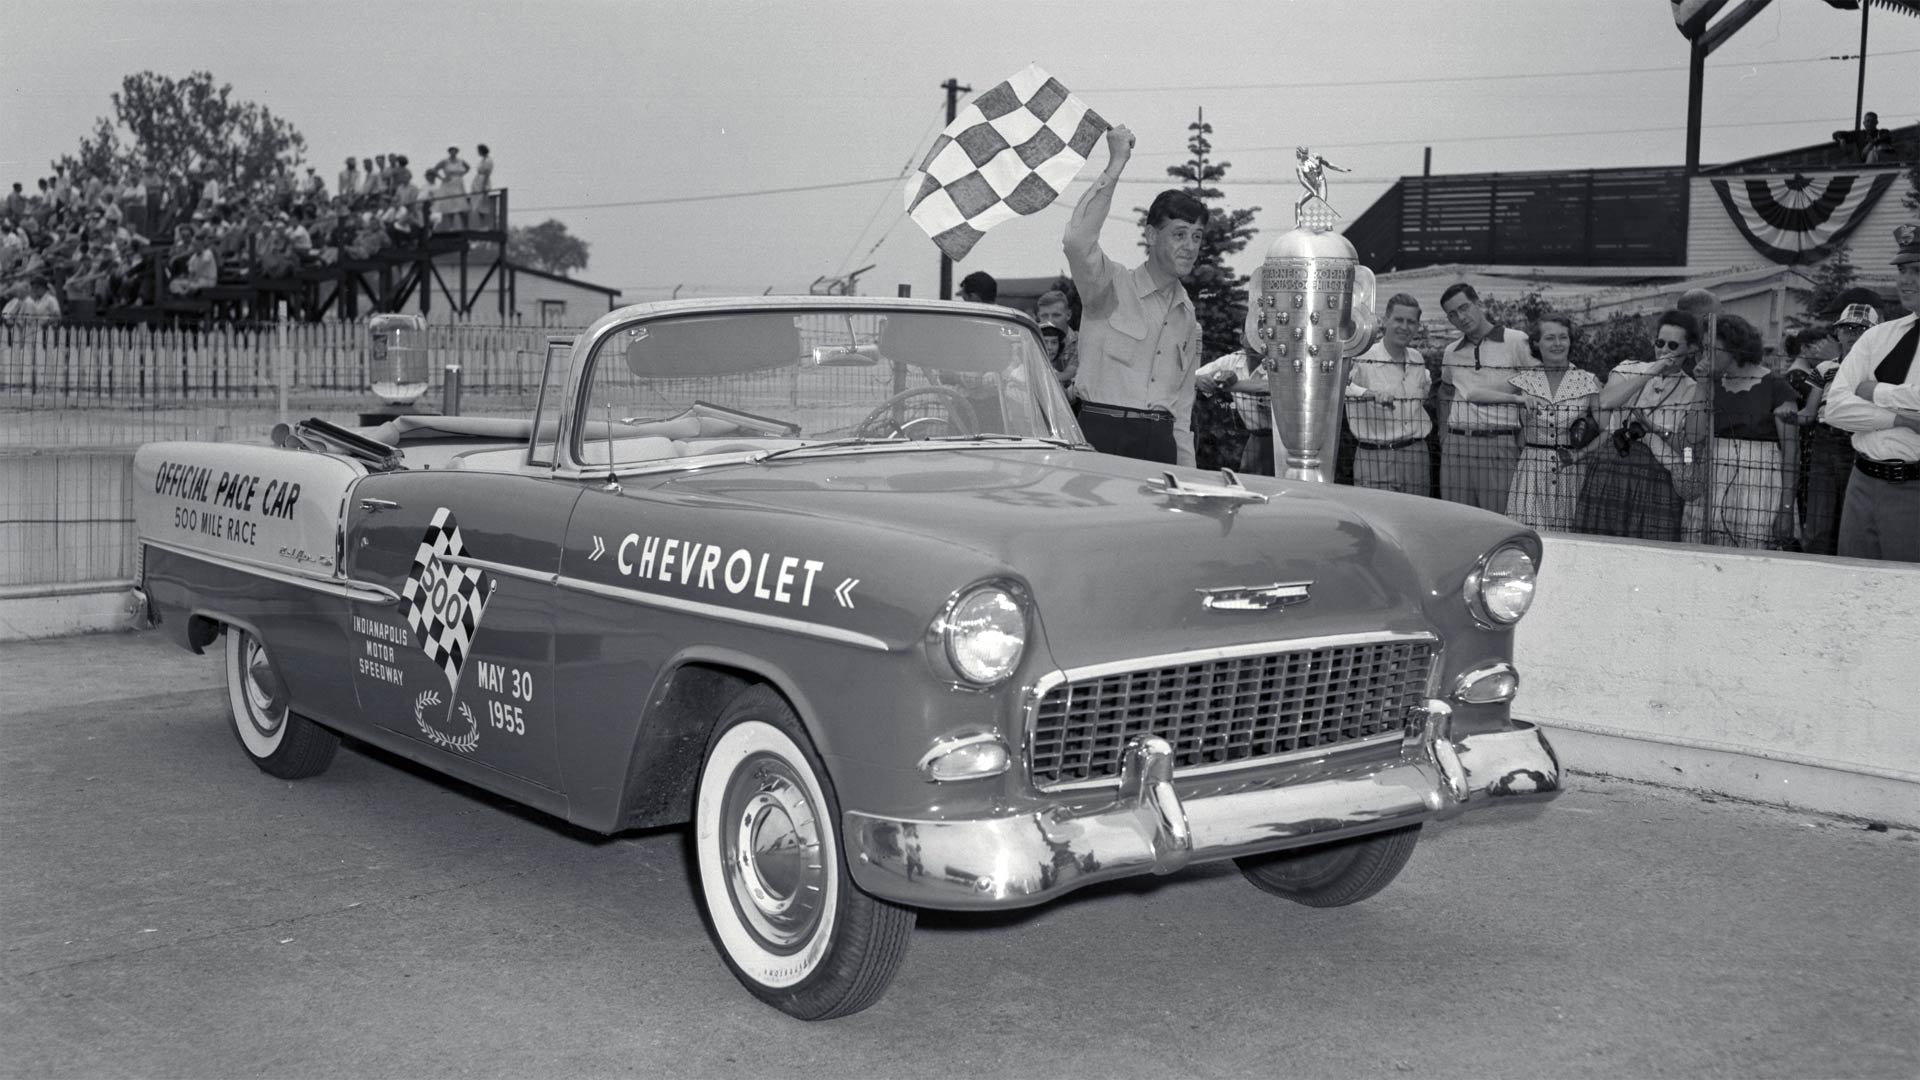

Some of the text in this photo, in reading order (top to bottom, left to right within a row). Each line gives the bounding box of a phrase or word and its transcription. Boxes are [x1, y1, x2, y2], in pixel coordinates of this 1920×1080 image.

[155, 461, 301, 520] OFFICIAL PACE CAR
[174, 507, 257, 546] 500 MILE RACE
[617, 533, 824, 607] CHEVROLET
[421, 552, 462, 630] 500
[353, 615, 408, 646] INDIANAPOLIS
[366, 640, 395, 663] MOTOR
[359, 657, 404, 686] SPEEDWAY
[478, 661, 533, 702] MAY 30
[488, 699, 526, 735] 1955
